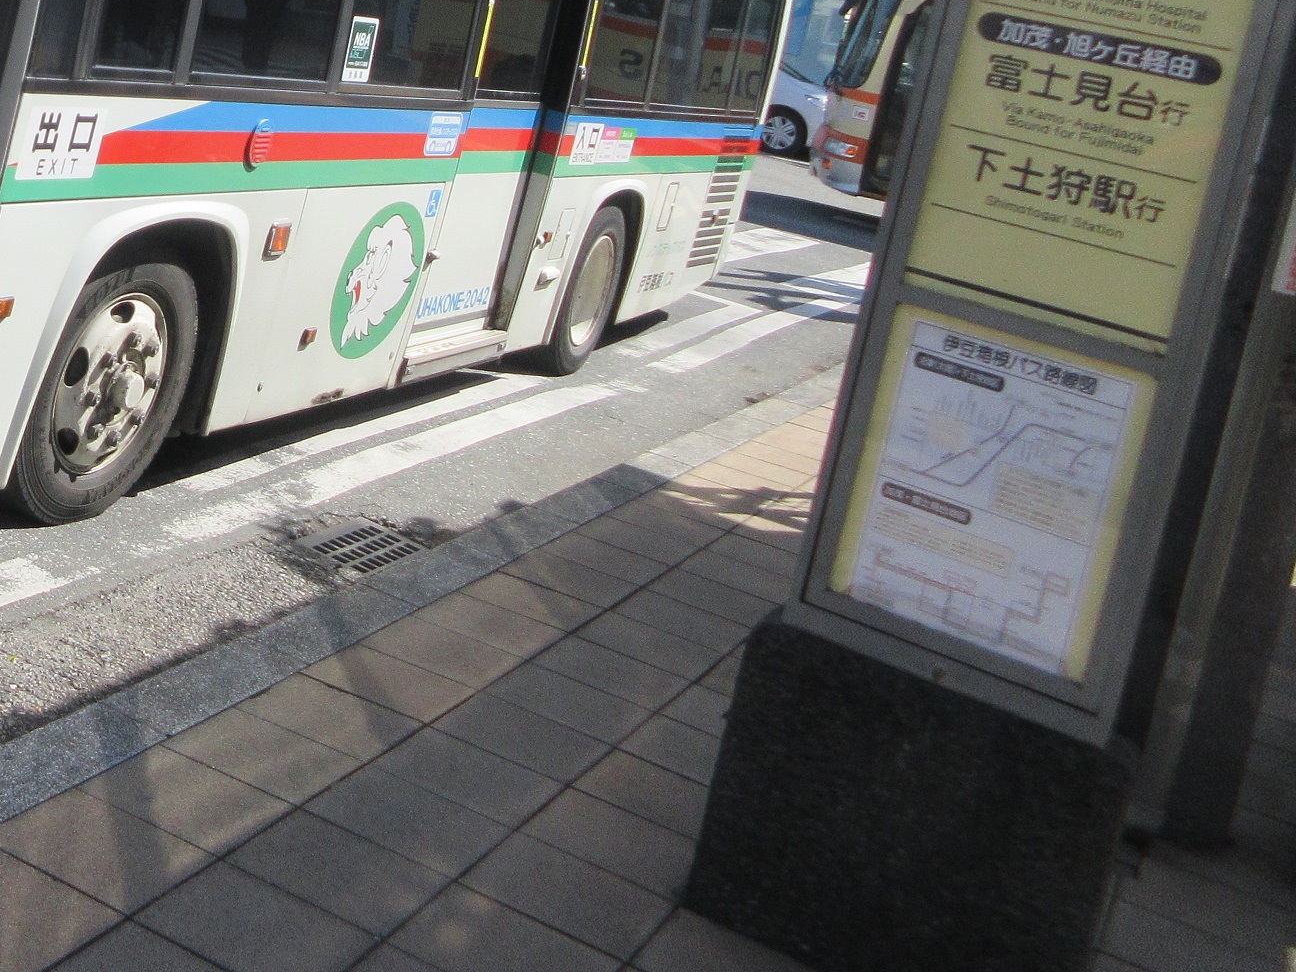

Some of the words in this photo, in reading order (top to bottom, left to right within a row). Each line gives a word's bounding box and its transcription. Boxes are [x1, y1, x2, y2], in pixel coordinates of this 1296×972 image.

[1148, 12, 1203, 34] Station
[353, 31, 372, 47] NBA
[985, 53, 1191, 128] 富士見台行
[32, 110, 101, 154] 出口
[576, 125, 601, 150] 入口
[36, 157, 80, 179] EXIT
[966, 143, 1167, 223] 下土狩駅行
